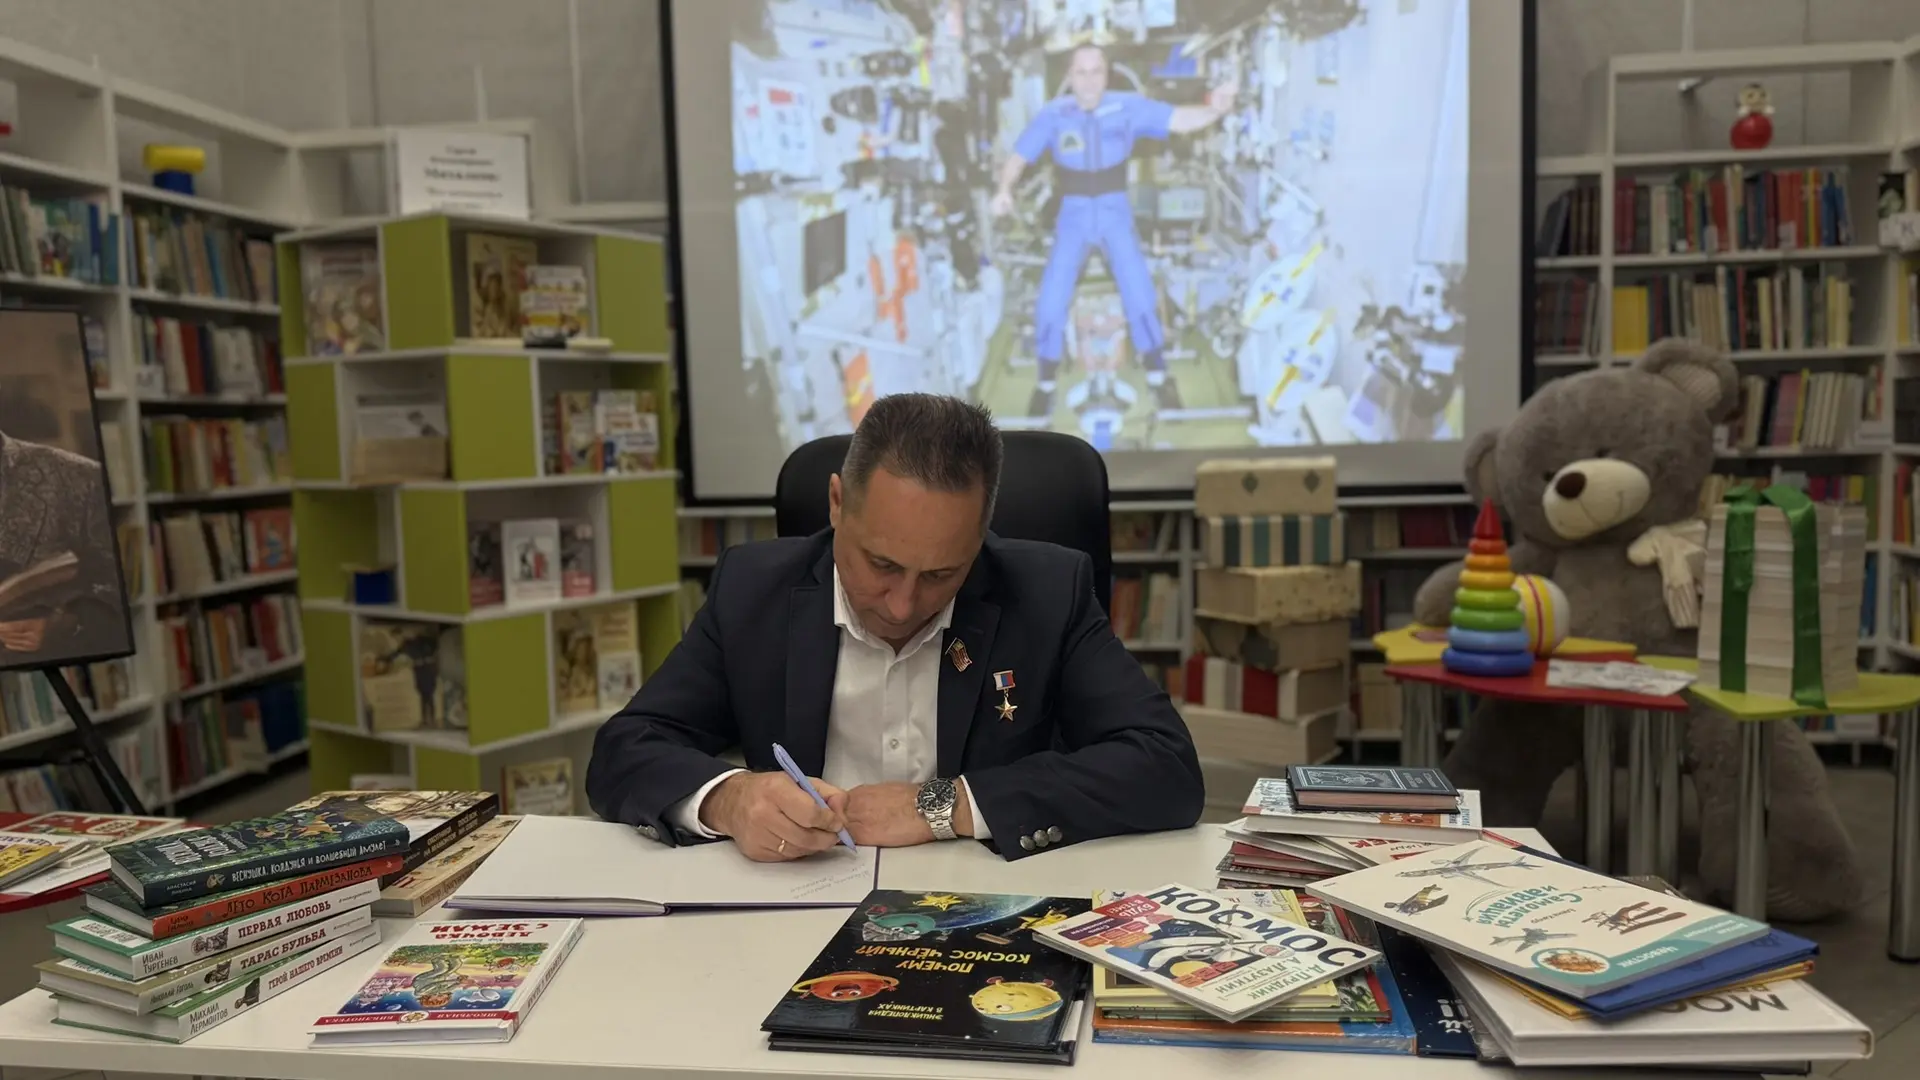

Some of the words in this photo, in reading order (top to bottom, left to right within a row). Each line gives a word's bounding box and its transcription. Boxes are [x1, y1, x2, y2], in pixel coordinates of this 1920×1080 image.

[262, 886, 294, 905] КОТА
[299, 866, 373, 895] ПАРМЕЗАНОВА
[1118, 903, 1155, 918] БУДЬ
[1476, 888, 1546, 925] авиация
[238, 912, 283, 938] ПЕРВАЯ
[286, 900, 332, 923] ЛЮБОВЬ
[1145, 886, 1367, 967] КОСМОС
[430, 923, 531, 934] ЗЕМЛИ
[435, 931, 534, 940] ДЕВОЧКА
[240, 949, 280, 970] ТАРАС
[281, 928, 327, 954] БУЛЬБА
[855, 944, 943, 959] ЧЁРНЫЙ?
[142, 950, 164, 965] ИВАН
[143, 956, 179, 974] ТУРГЕНЕВ
[950, 950, 1031, 965] КОСМОС
[268, 972, 288, 990] ГЕРОЙ
[289, 960, 315, 980] НАШЕГО
[316, 945, 343, 966] ВРЕМЕНИ
[896, 960, 975, 974] ПОЧЕМУ
[189, 1002, 220, 1023] МИХАИЛ
[867, 1009, 944, 1021] ЭНЦИКЛОПЕДИЯ
[877, 1003, 934, 1013] КАРТИНКАХ
[190, 1009, 229, 1035] ЛЕРМОНТОВ
[325, 1015, 394, 1024] БИБЛИОТЕКА
